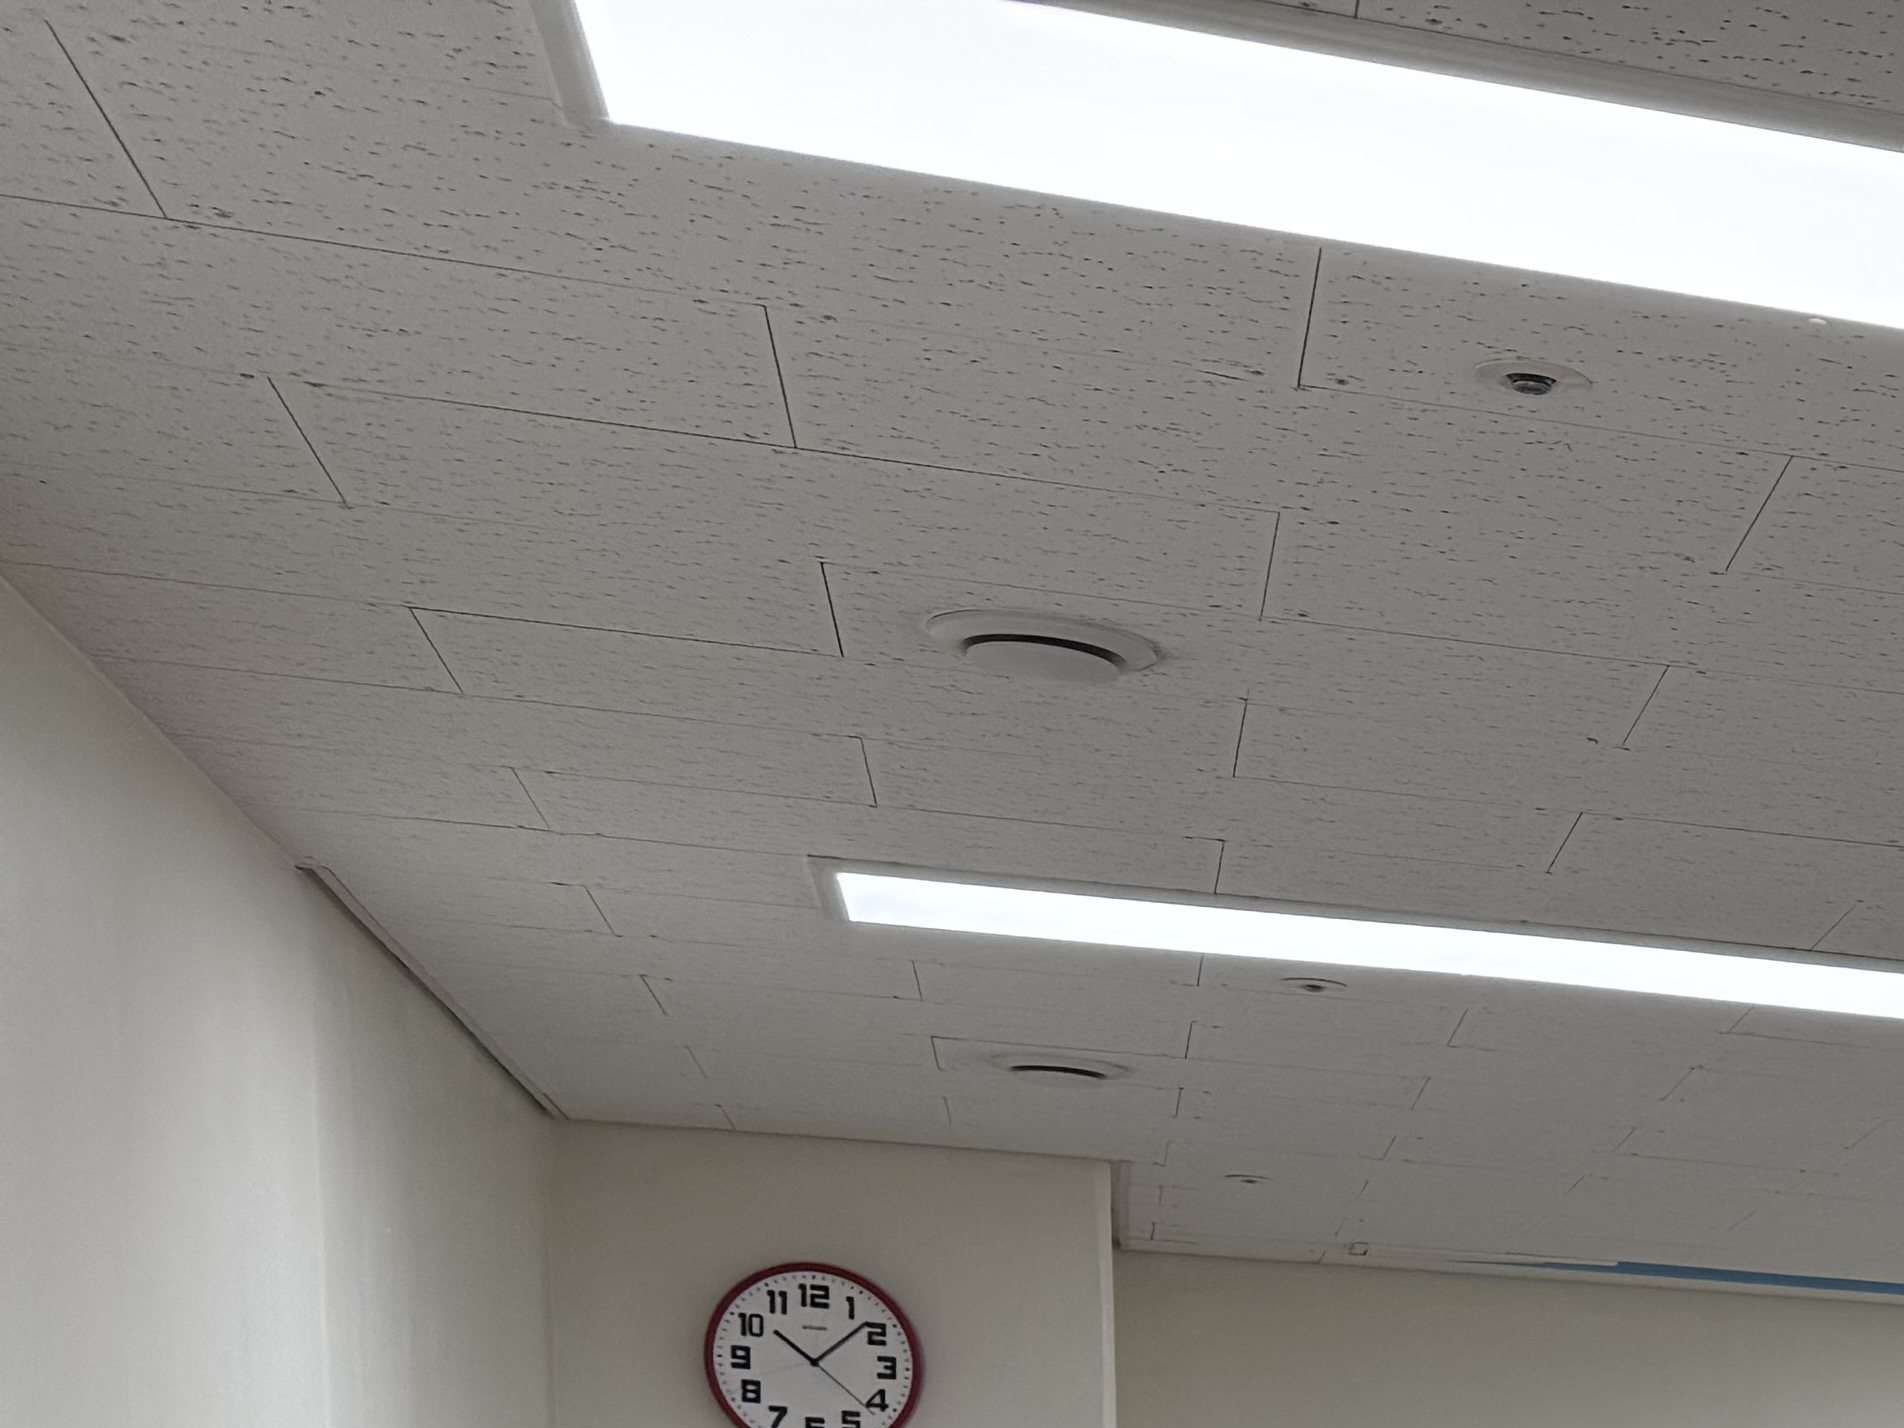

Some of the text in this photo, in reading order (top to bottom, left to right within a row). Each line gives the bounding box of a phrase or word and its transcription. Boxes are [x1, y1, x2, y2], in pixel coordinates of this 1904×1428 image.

[767, 1290, 788, 1315] 11
[798, 1283, 830, 1309] 12
[846, 1297, 855, 1320] 1
[738, 1312, 764, 1337] 10
[866, 1322, 887, 1346] 2
[730, 1345, 751, 1370] 9
[877, 1355, 897, 1380] 3
[740, 1379, 761, 1404] 8
[865, 1389, 888, 1412] 4
[768, 1405, 788, 1428] 7
